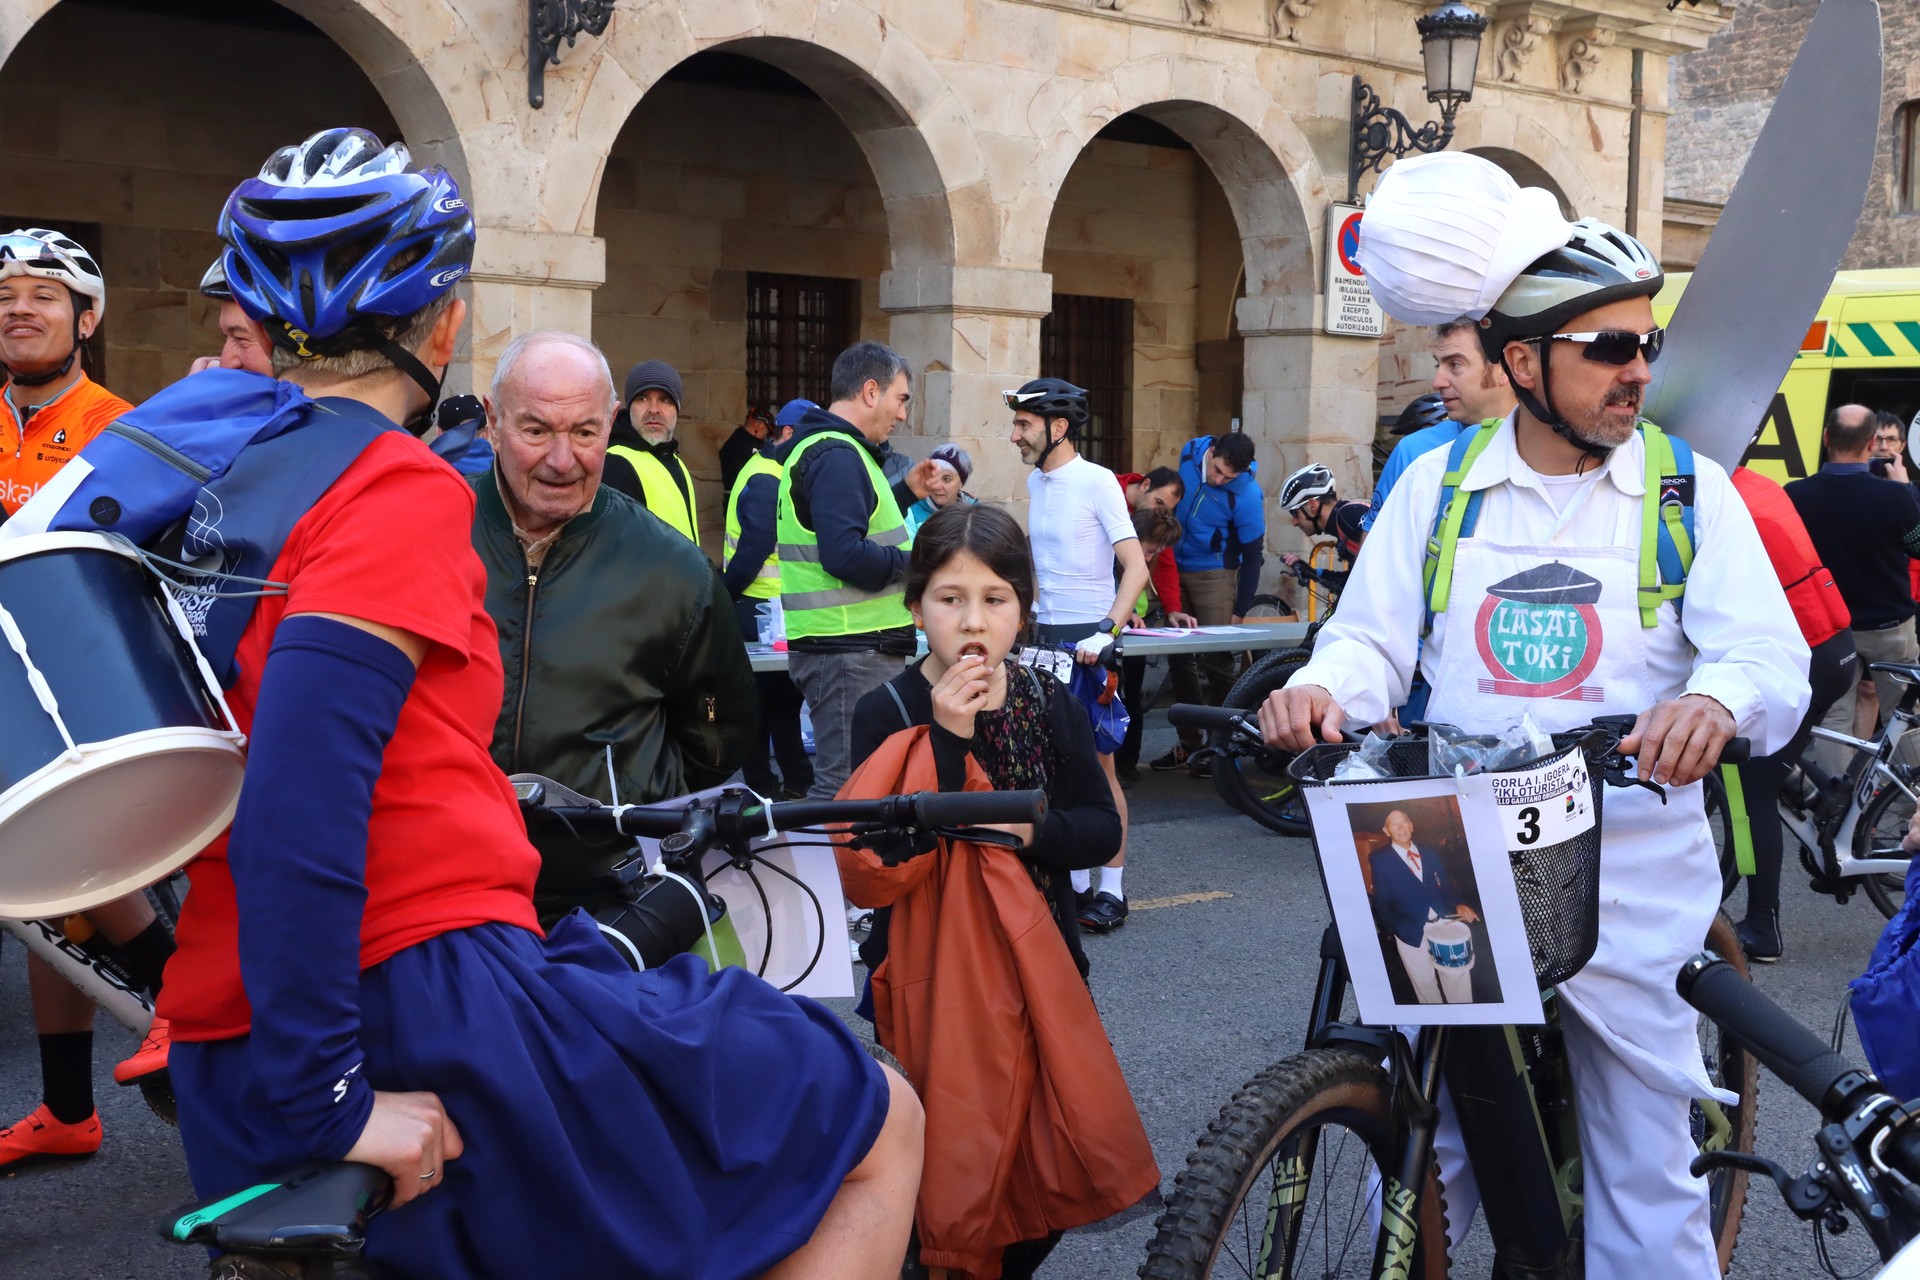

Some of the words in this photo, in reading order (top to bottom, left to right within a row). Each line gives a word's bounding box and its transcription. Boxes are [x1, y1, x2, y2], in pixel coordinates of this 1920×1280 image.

[1334, 277, 1368, 288] BAIMENDUT
[1338, 286, 1373, 296] IBILGAILUA
[1341, 295, 1356, 303] IZAN
[1358, 296, 1371, 304] EZIK
[1342, 306, 1370, 315] EXCEPTO
[1340, 315, 1373, 324] VEHICULOS
[1336, 322, 1378, 333] AUTORIZADOS
[1492, 777, 1532, 788] GORLA
[1544, 763, 1570, 782] IGOERA
[1516, 806, 1541, 845] 3
[22, 920, 152, 1013] RBEA
